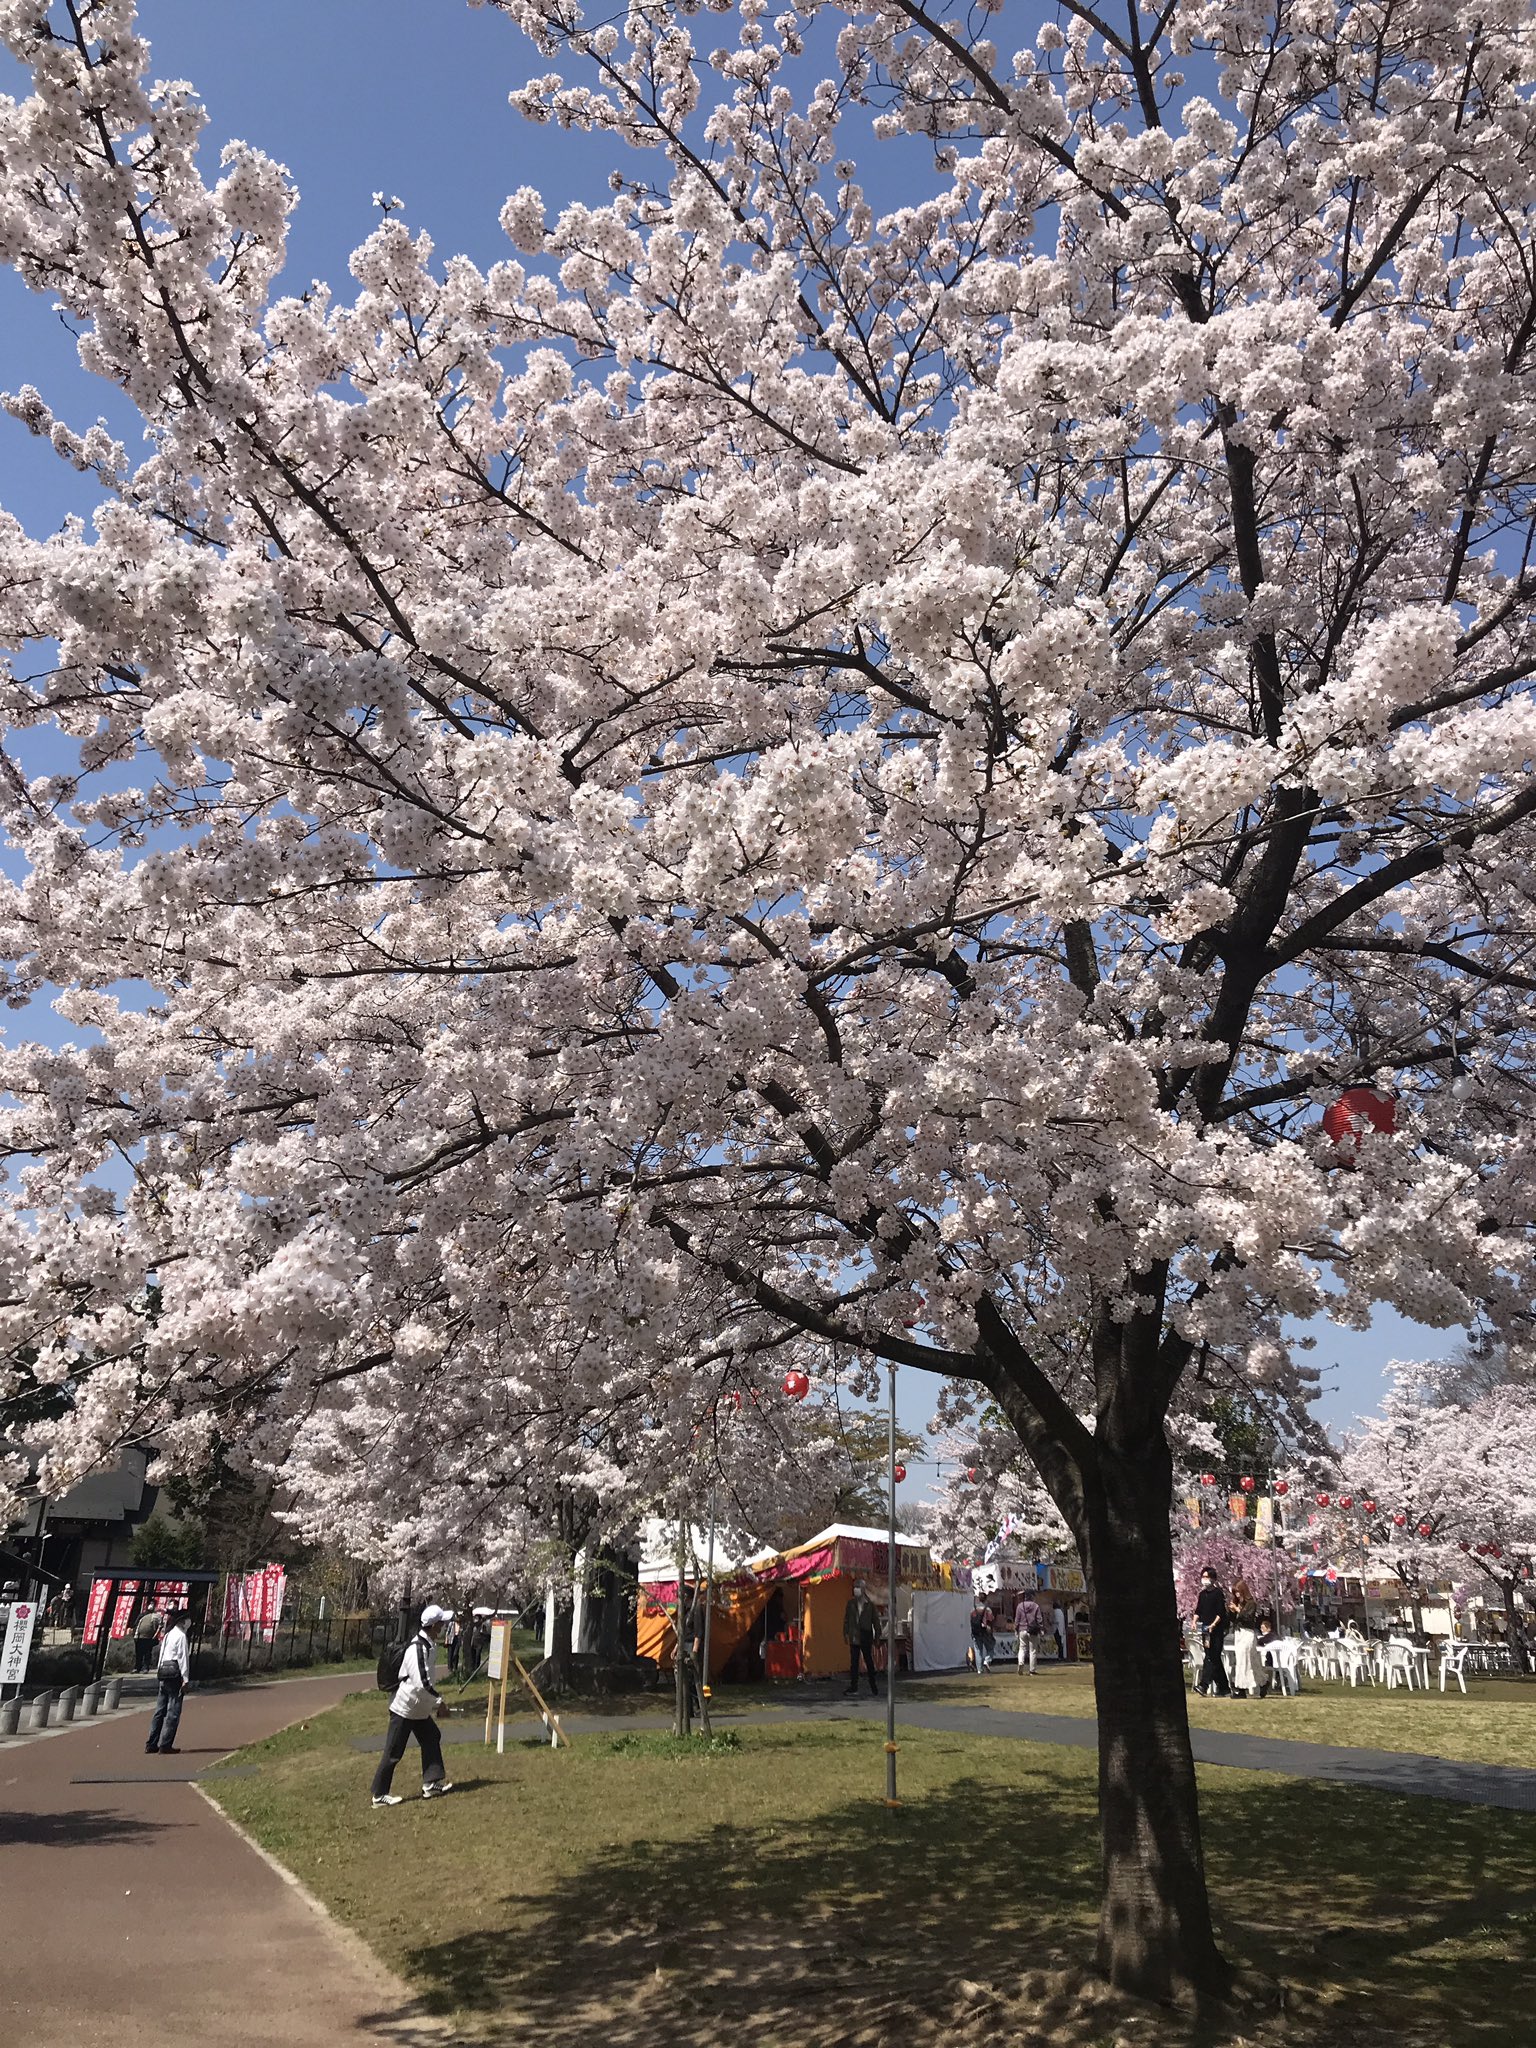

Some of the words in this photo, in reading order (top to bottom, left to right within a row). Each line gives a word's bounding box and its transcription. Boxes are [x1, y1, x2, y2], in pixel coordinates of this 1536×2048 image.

[6, 1620, 28, 1681] 櫻岡大神宮
